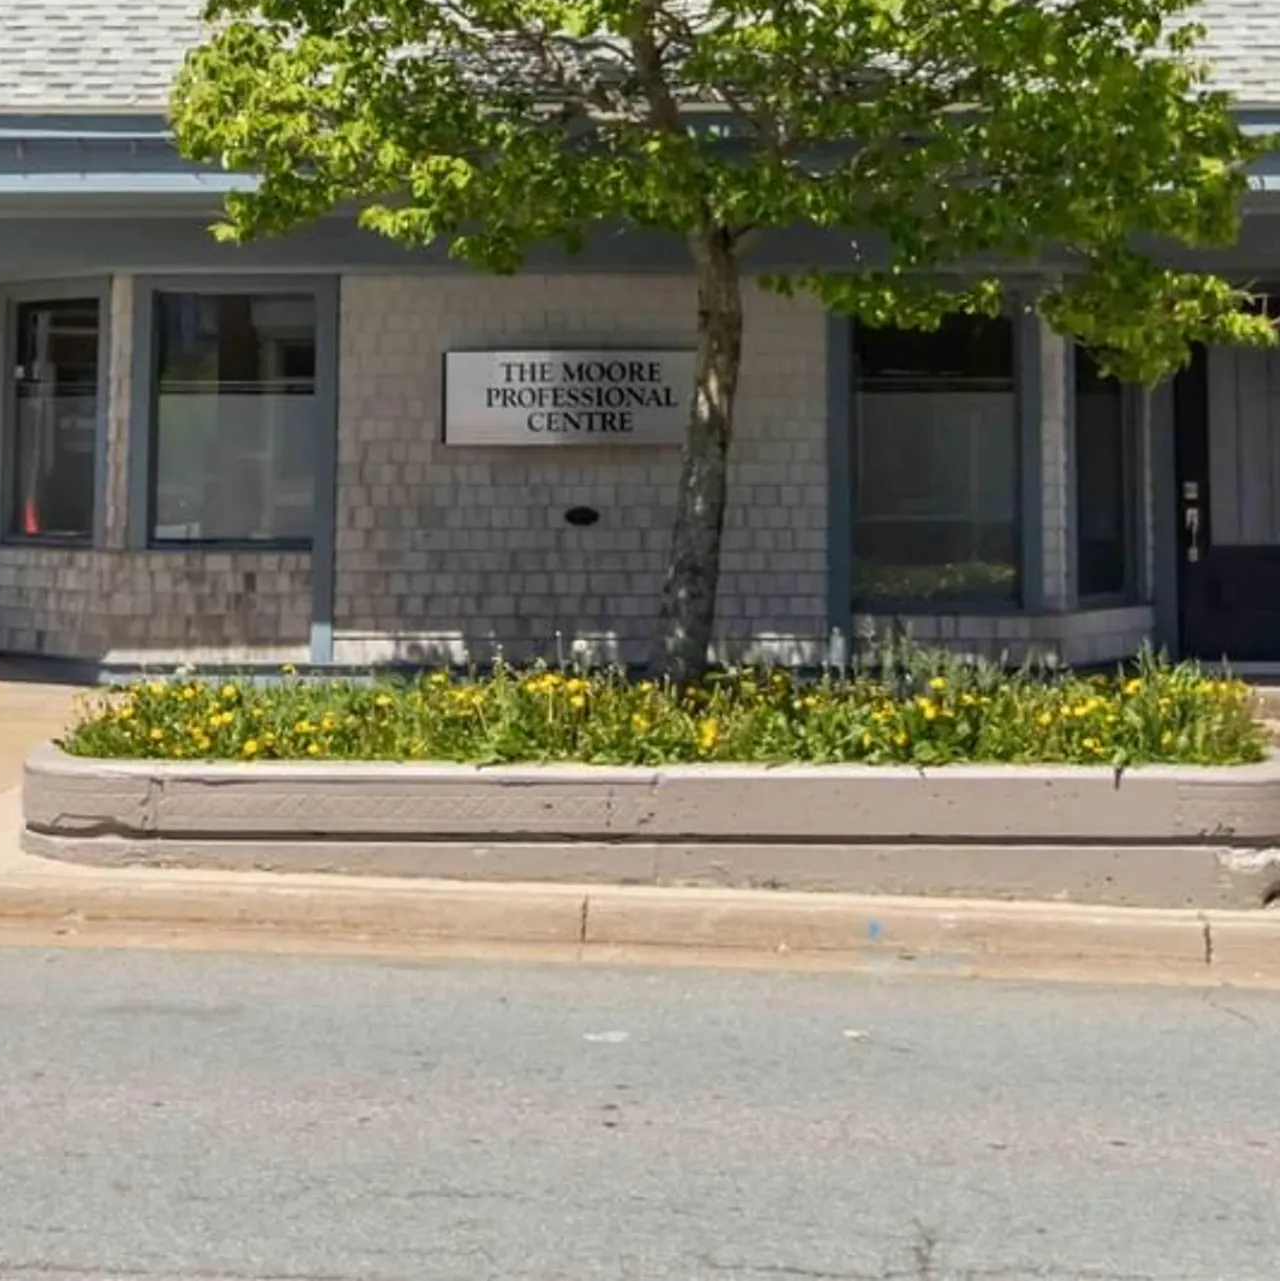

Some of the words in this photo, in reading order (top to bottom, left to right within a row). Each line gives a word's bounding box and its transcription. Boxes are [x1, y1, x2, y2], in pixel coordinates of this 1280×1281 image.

[500, 361, 554, 383] THE
[562, 361, 662, 383] MOORE
[486, 387, 678, 408] PROFESSIONAL
[527, 411, 633, 433] CENTRE
